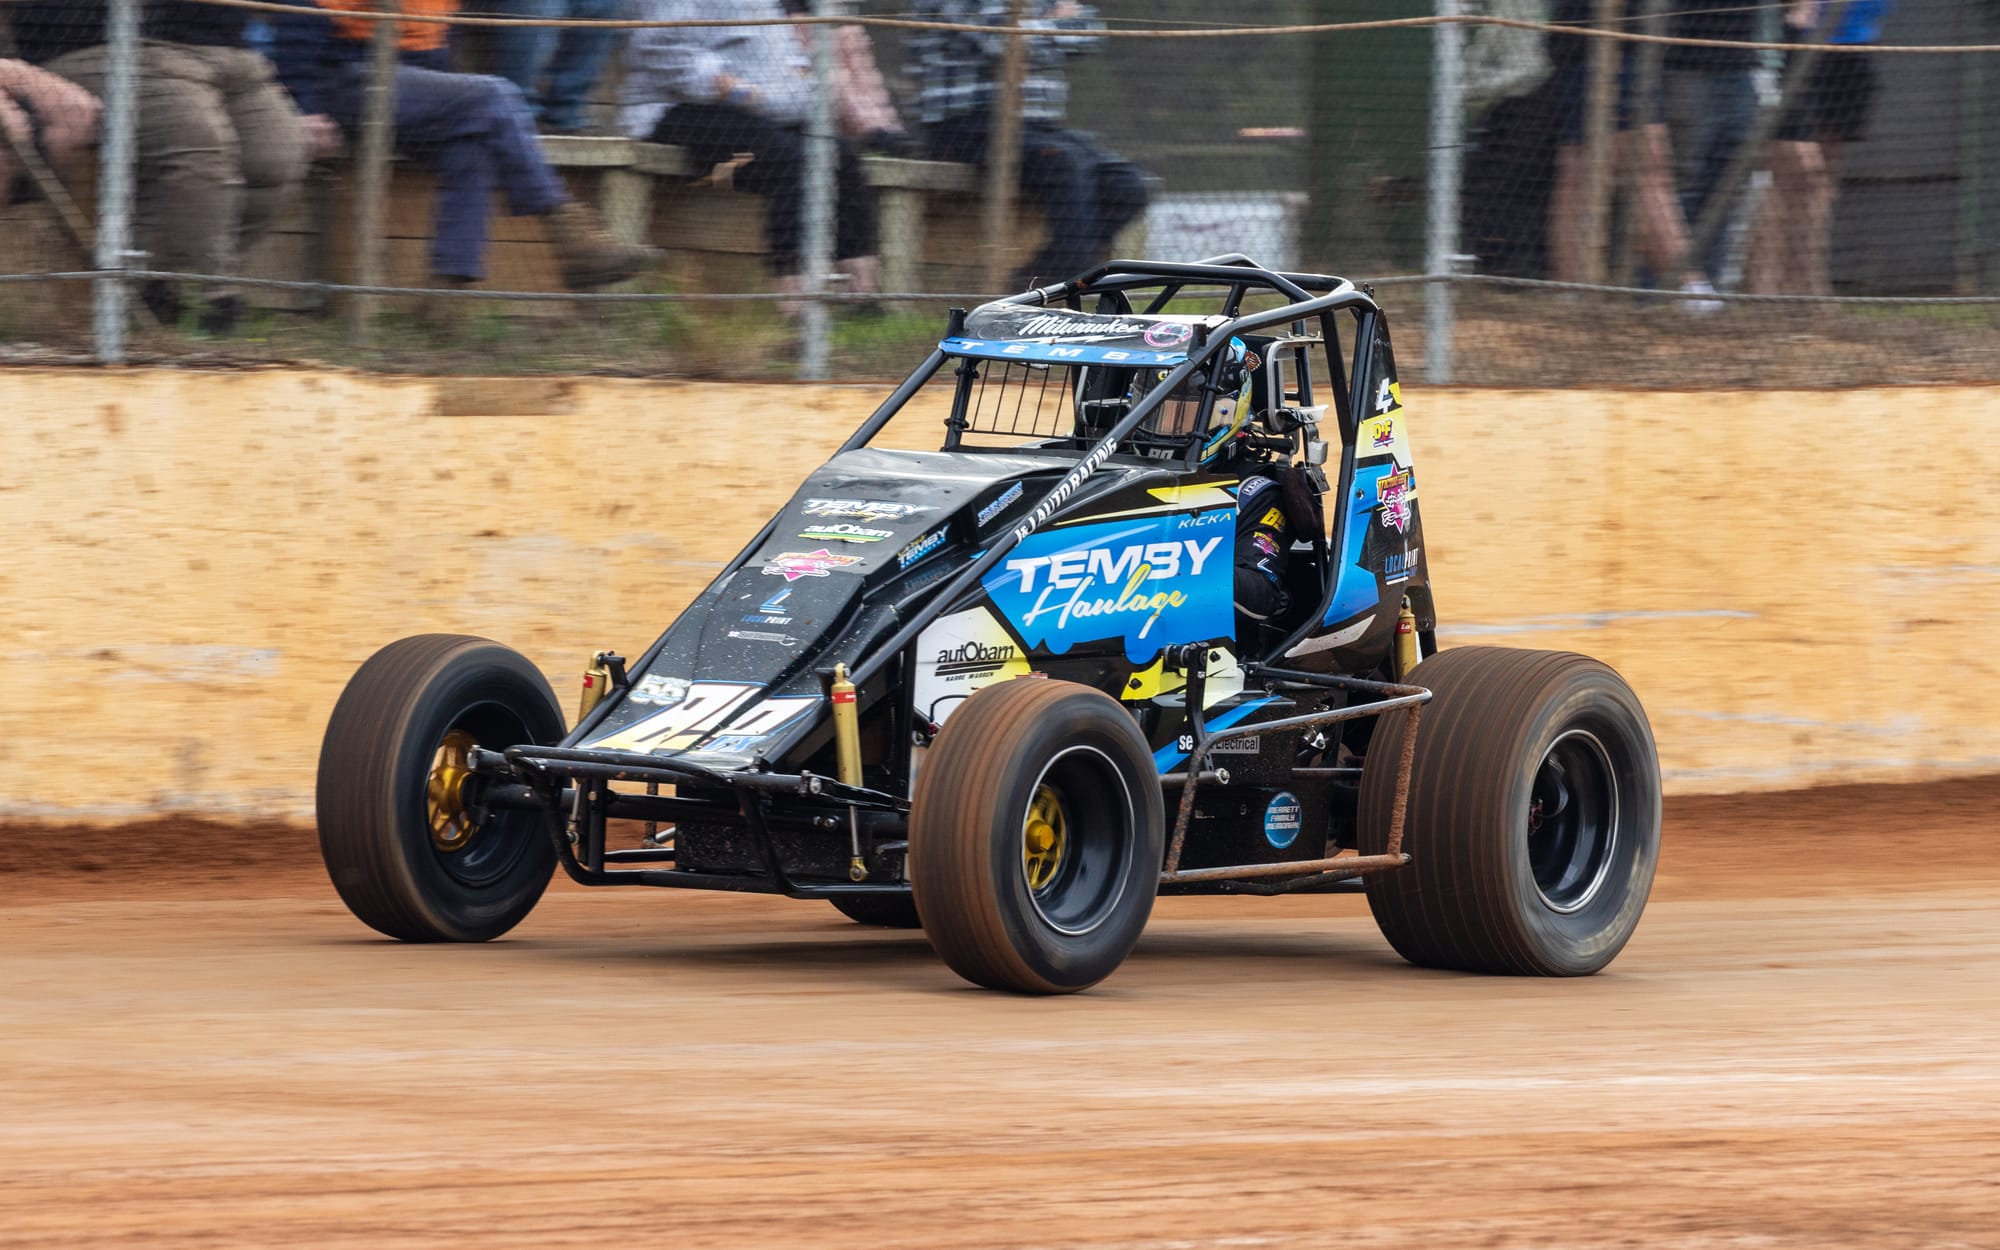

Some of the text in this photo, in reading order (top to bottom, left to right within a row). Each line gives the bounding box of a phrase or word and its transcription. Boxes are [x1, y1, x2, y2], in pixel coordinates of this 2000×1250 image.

[1018, 313, 1142, 336] Milwaukee
[961, 340, 1176, 362] TEMBY
[897, 523, 952, 566] TEMBY
[1006, 536, 1224, 593] TEMBY
[1022, 563, 1188, 640] Haulage
